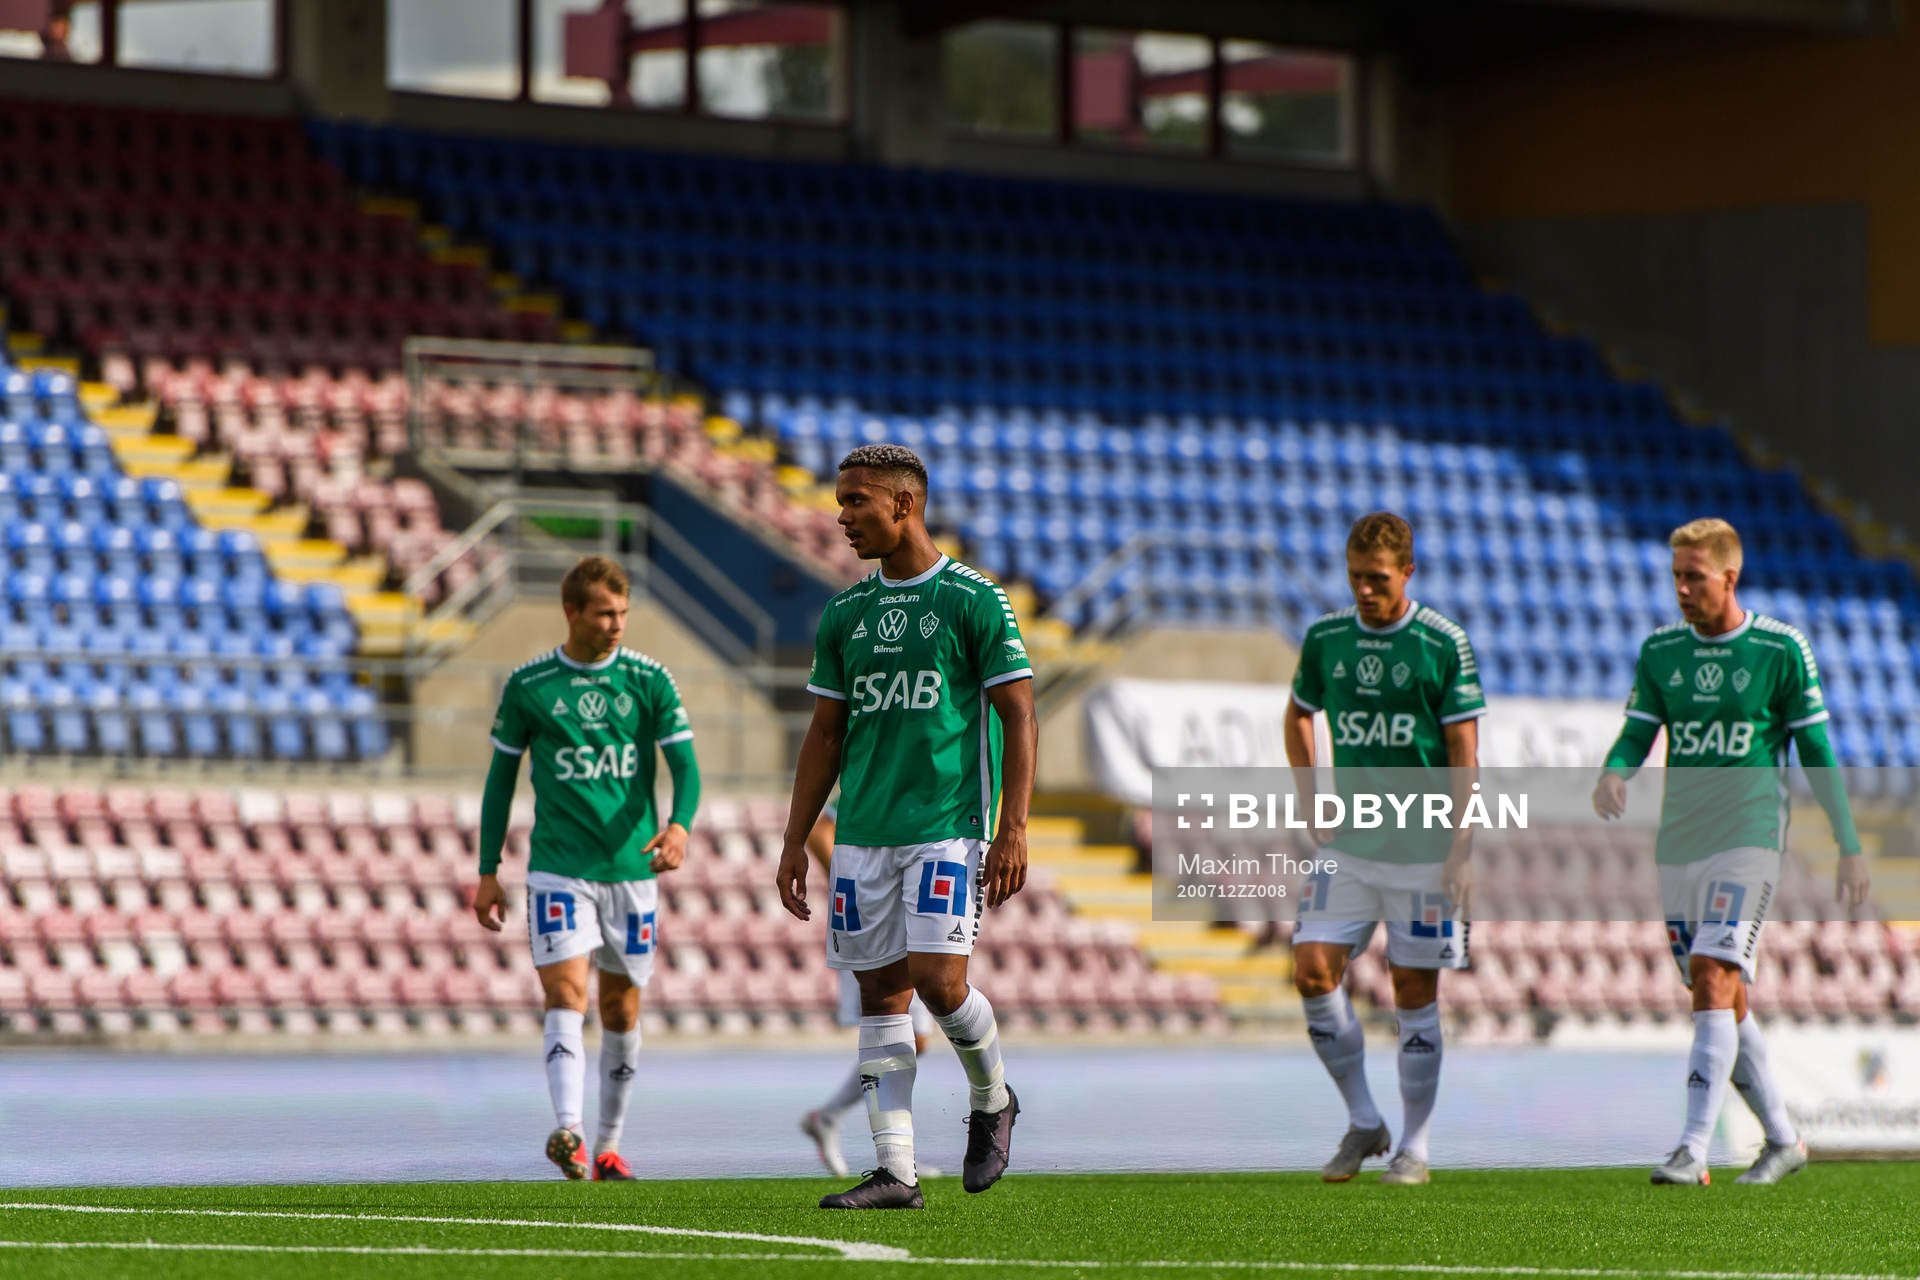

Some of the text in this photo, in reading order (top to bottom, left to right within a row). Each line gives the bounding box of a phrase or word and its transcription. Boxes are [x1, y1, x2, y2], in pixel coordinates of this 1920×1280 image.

[878, 594, 920, 605] stadium
[851, 669, 943, 717] SSAB
[1336, 710, 1417, 747] SSAB
[1671, 720, 1756, 757] SSAB
[555, 743, 638, 781] SSAB
[832, 930, 840, 953] 8
[947, 935, 966, 944] SELECT
